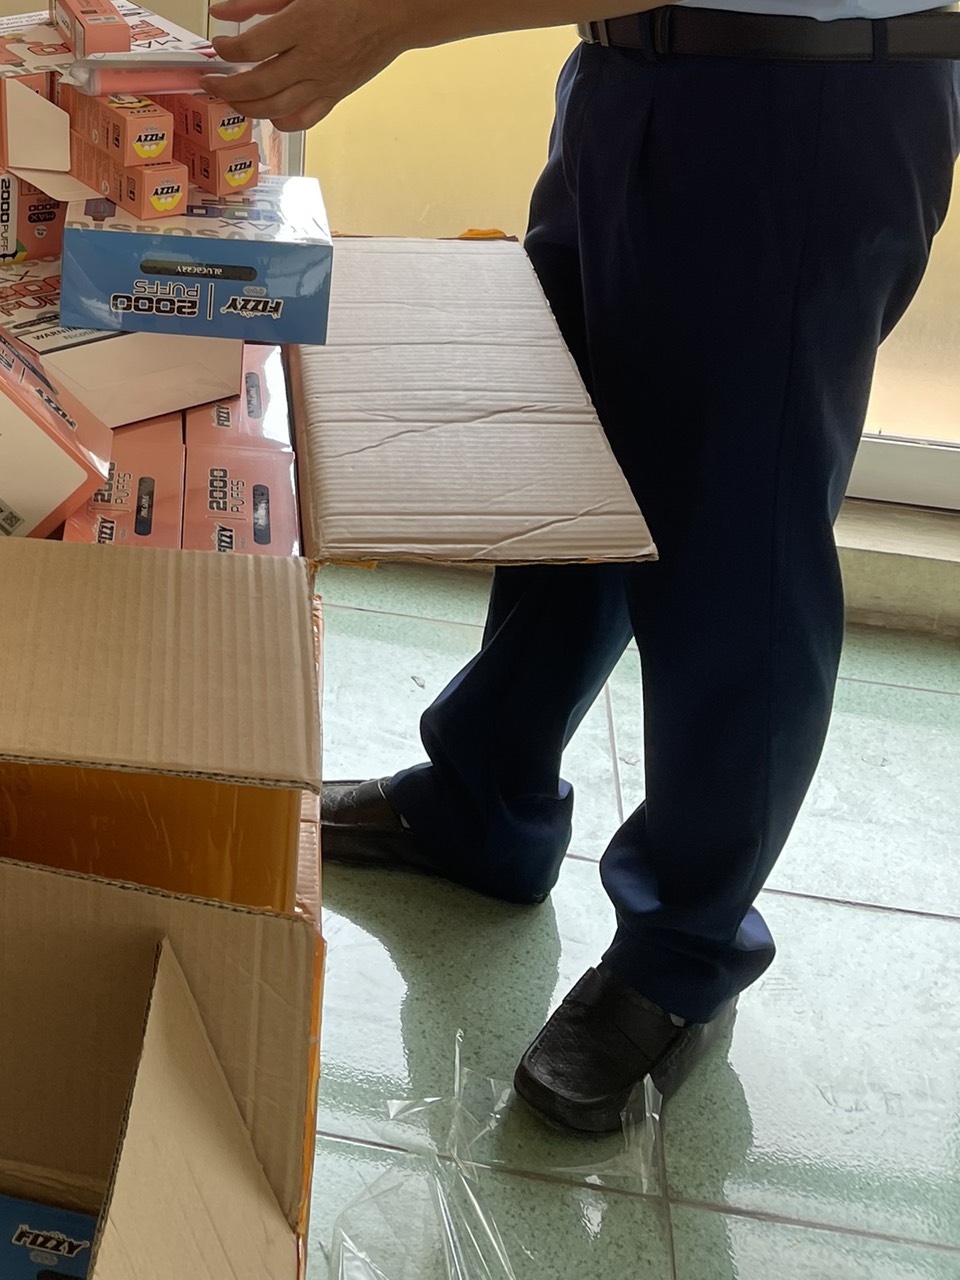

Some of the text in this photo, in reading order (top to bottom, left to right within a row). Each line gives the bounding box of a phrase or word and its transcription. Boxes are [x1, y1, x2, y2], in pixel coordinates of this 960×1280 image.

[220, 115, 246, 128] FIZZY
[135, 132, 166, 144] FIZZY
[227, 160, 253, 174] FIZZY
[153, 184, 181, 197] FIZZY
[133, 280, 200, 298] PUFFS
[110, 292, 199, 317] 2000
[221, 295, 284, 320] FIZZY
[216, 403, 230, 428] FIZZY
[115, 472, 132, 505] PUFFS
[209, 468, 228, 512] 2000
[231, 480, 245, 513] PUFFS
[10, 1225, 90, 1258] FIZZY
